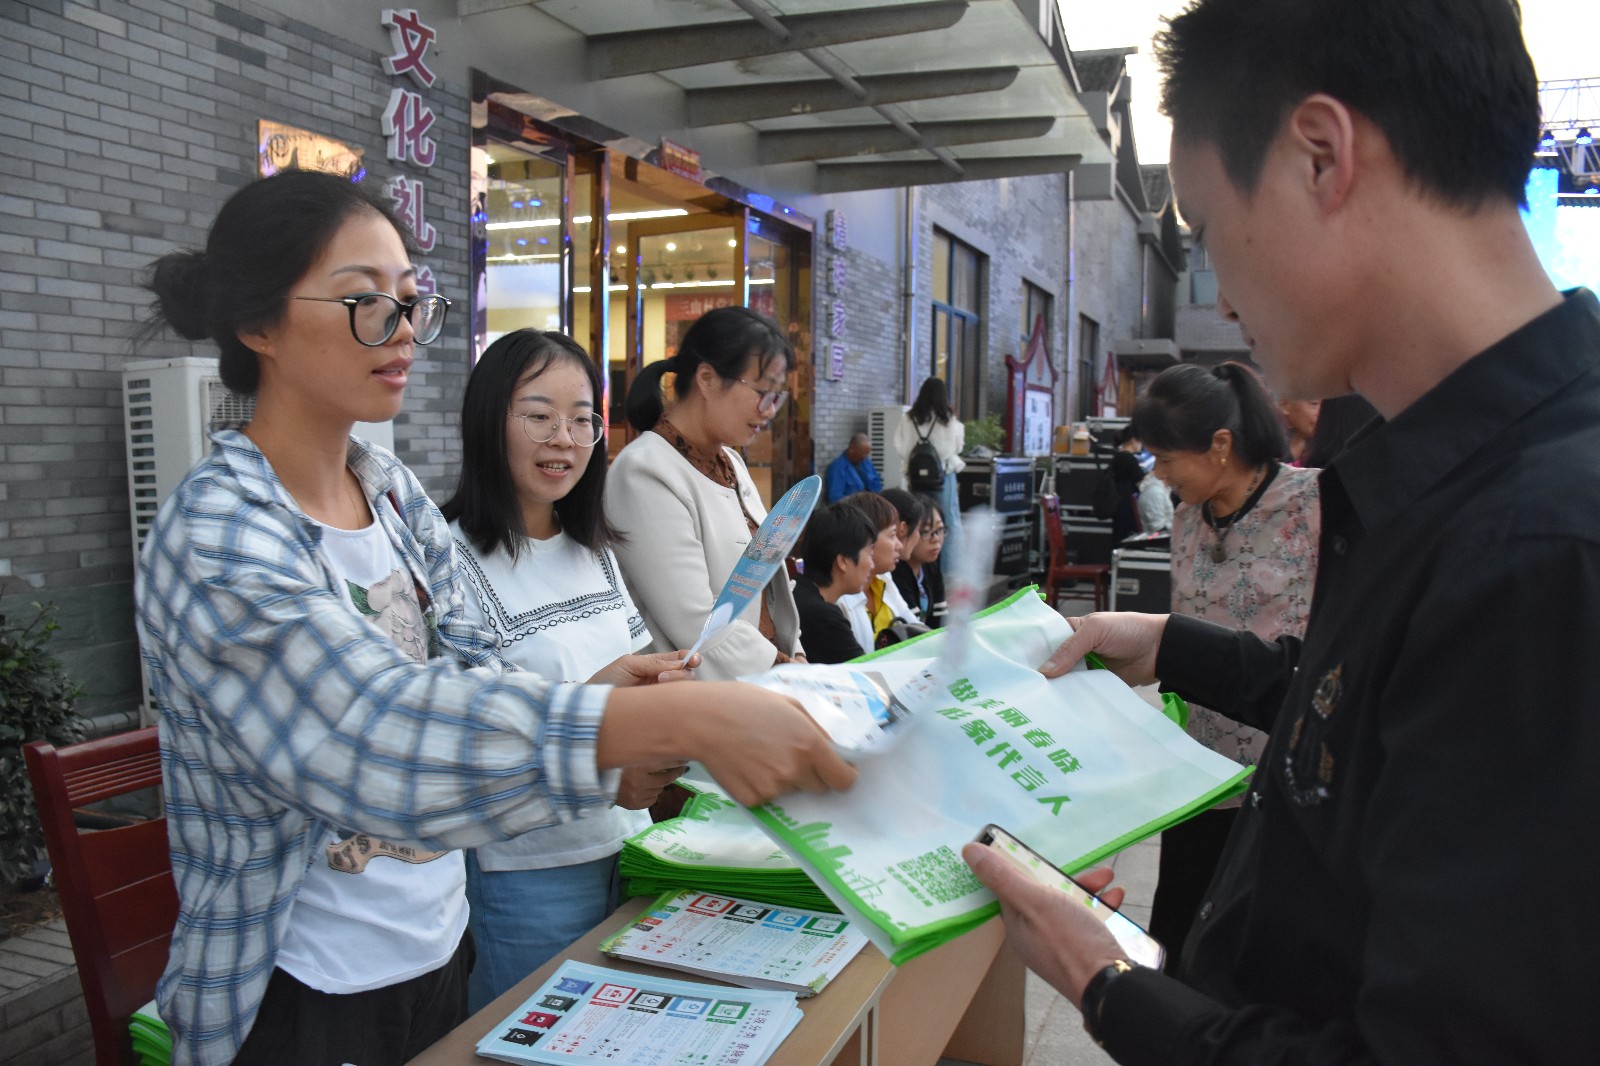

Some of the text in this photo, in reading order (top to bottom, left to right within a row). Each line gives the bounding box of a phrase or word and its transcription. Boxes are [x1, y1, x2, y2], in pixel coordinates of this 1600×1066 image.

[385, 9, 436, 296] 文化礼
[936, 707, 1071, 816] 形象代言人
[947, 677, 1083, 775] 做美丽春晓
